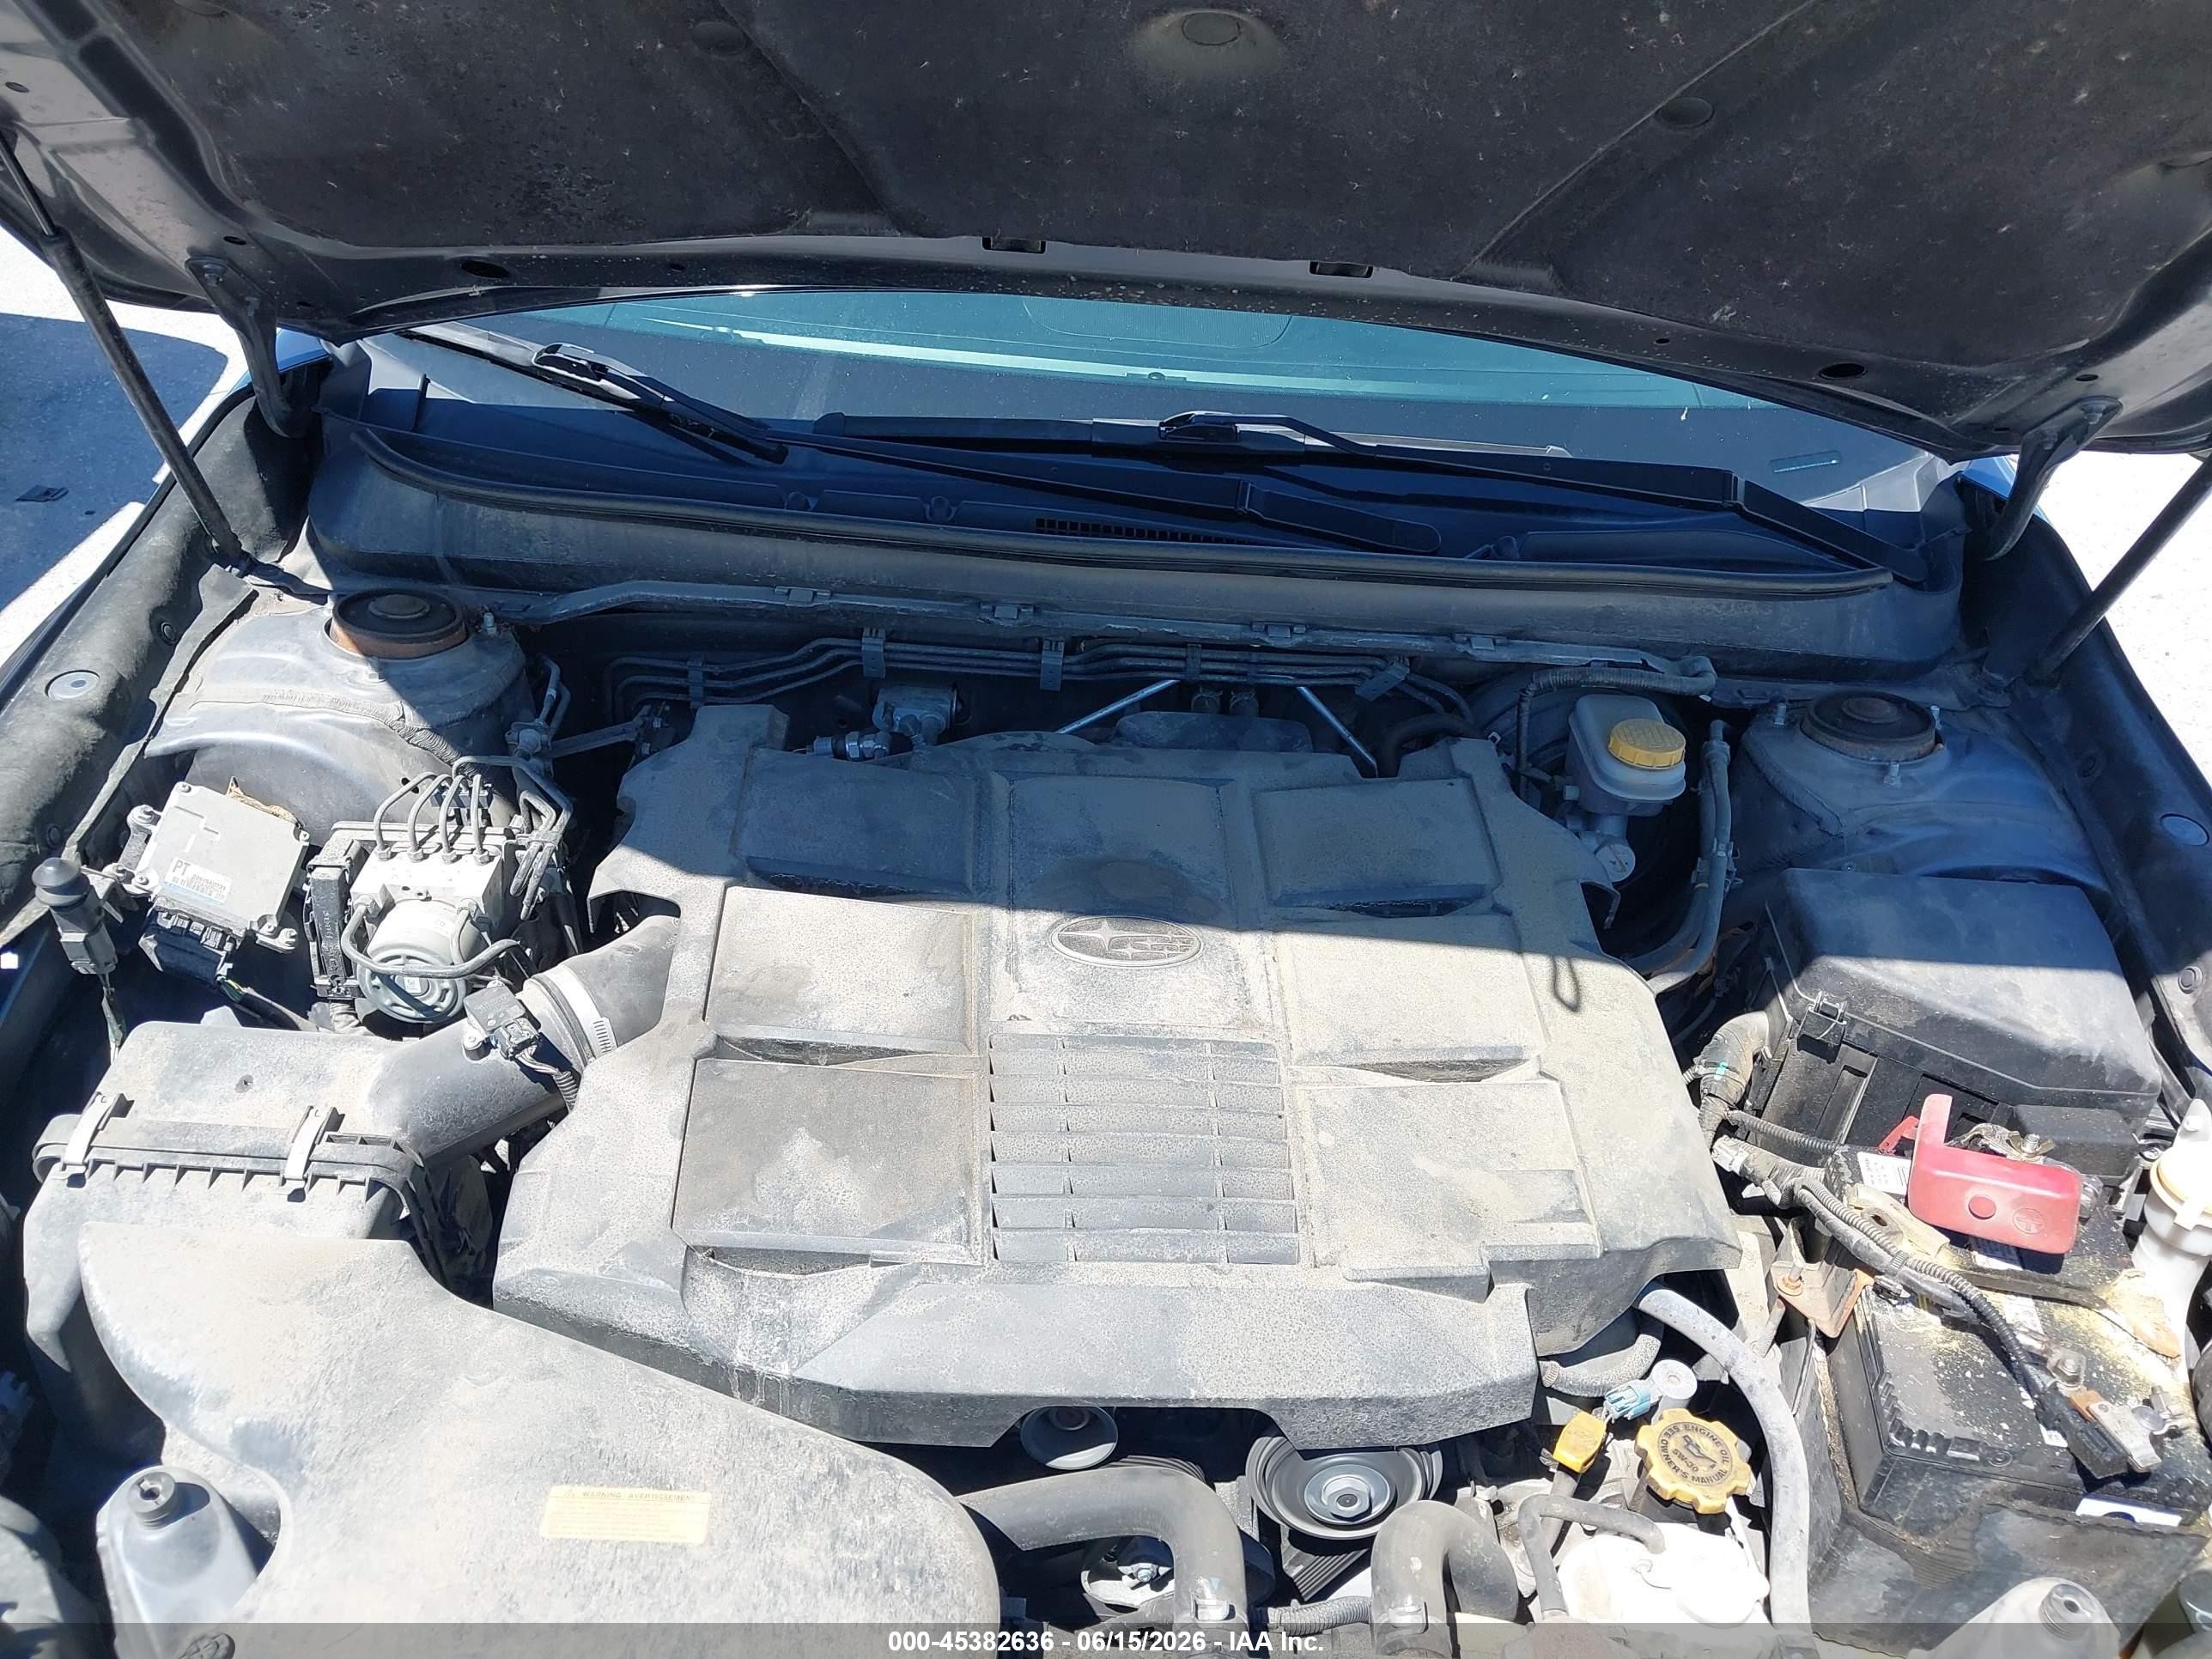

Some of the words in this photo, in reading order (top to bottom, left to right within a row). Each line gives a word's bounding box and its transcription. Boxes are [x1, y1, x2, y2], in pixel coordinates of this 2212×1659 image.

[173, 860, 191, 876] PT
[1663, 1425, 1680, 1438] SEE
[1684, 1424, 1723, 1448] ENGINE
[1720, 1449, 1729, 1464] OIL
[1661, 1438, 1690, 1479] OWNER'S
[1672, 1449, 1698, 1472] 5W-30
[1691, 1468, 1728, 1484] MANUAL
